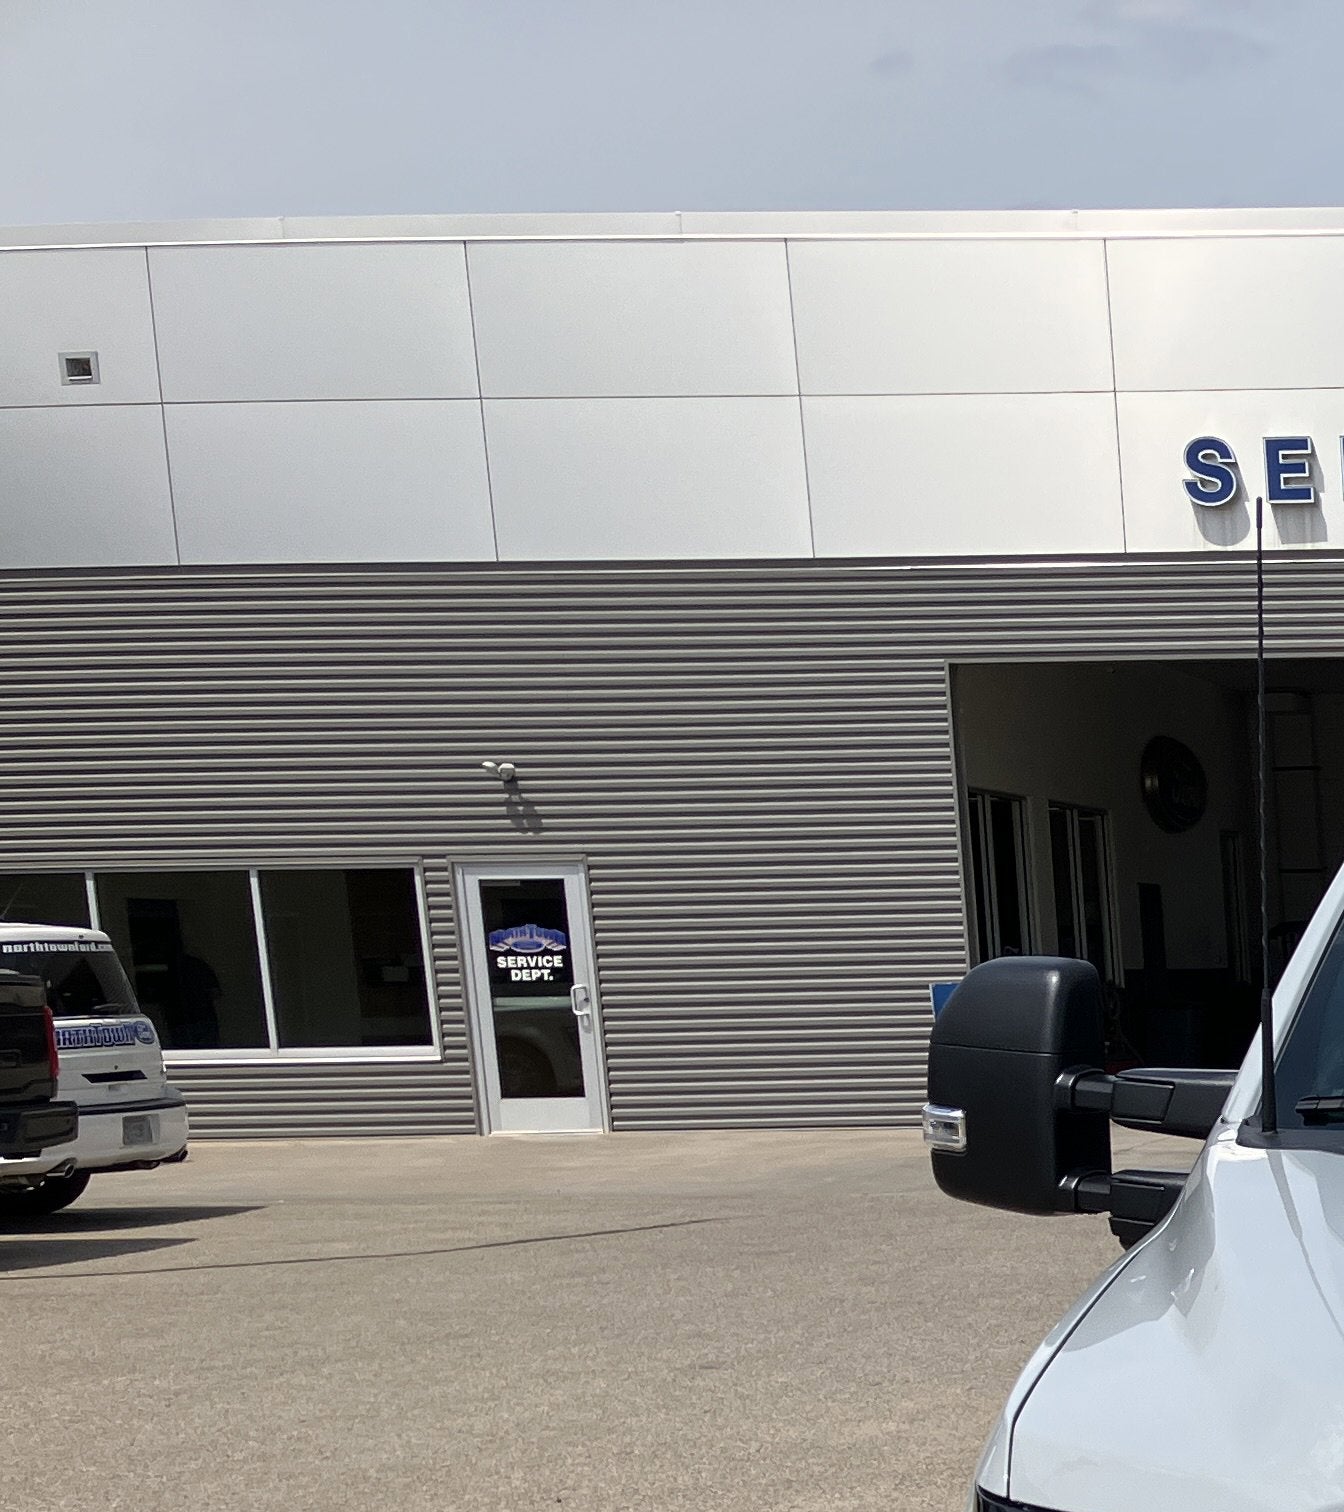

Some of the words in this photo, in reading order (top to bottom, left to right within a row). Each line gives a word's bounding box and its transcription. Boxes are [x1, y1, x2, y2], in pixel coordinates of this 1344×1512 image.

[2, 941, 113, 953] northtownford.
[497, 955, 563, 968] SERVICE
[511, 969, 553, 981] DEPT.
